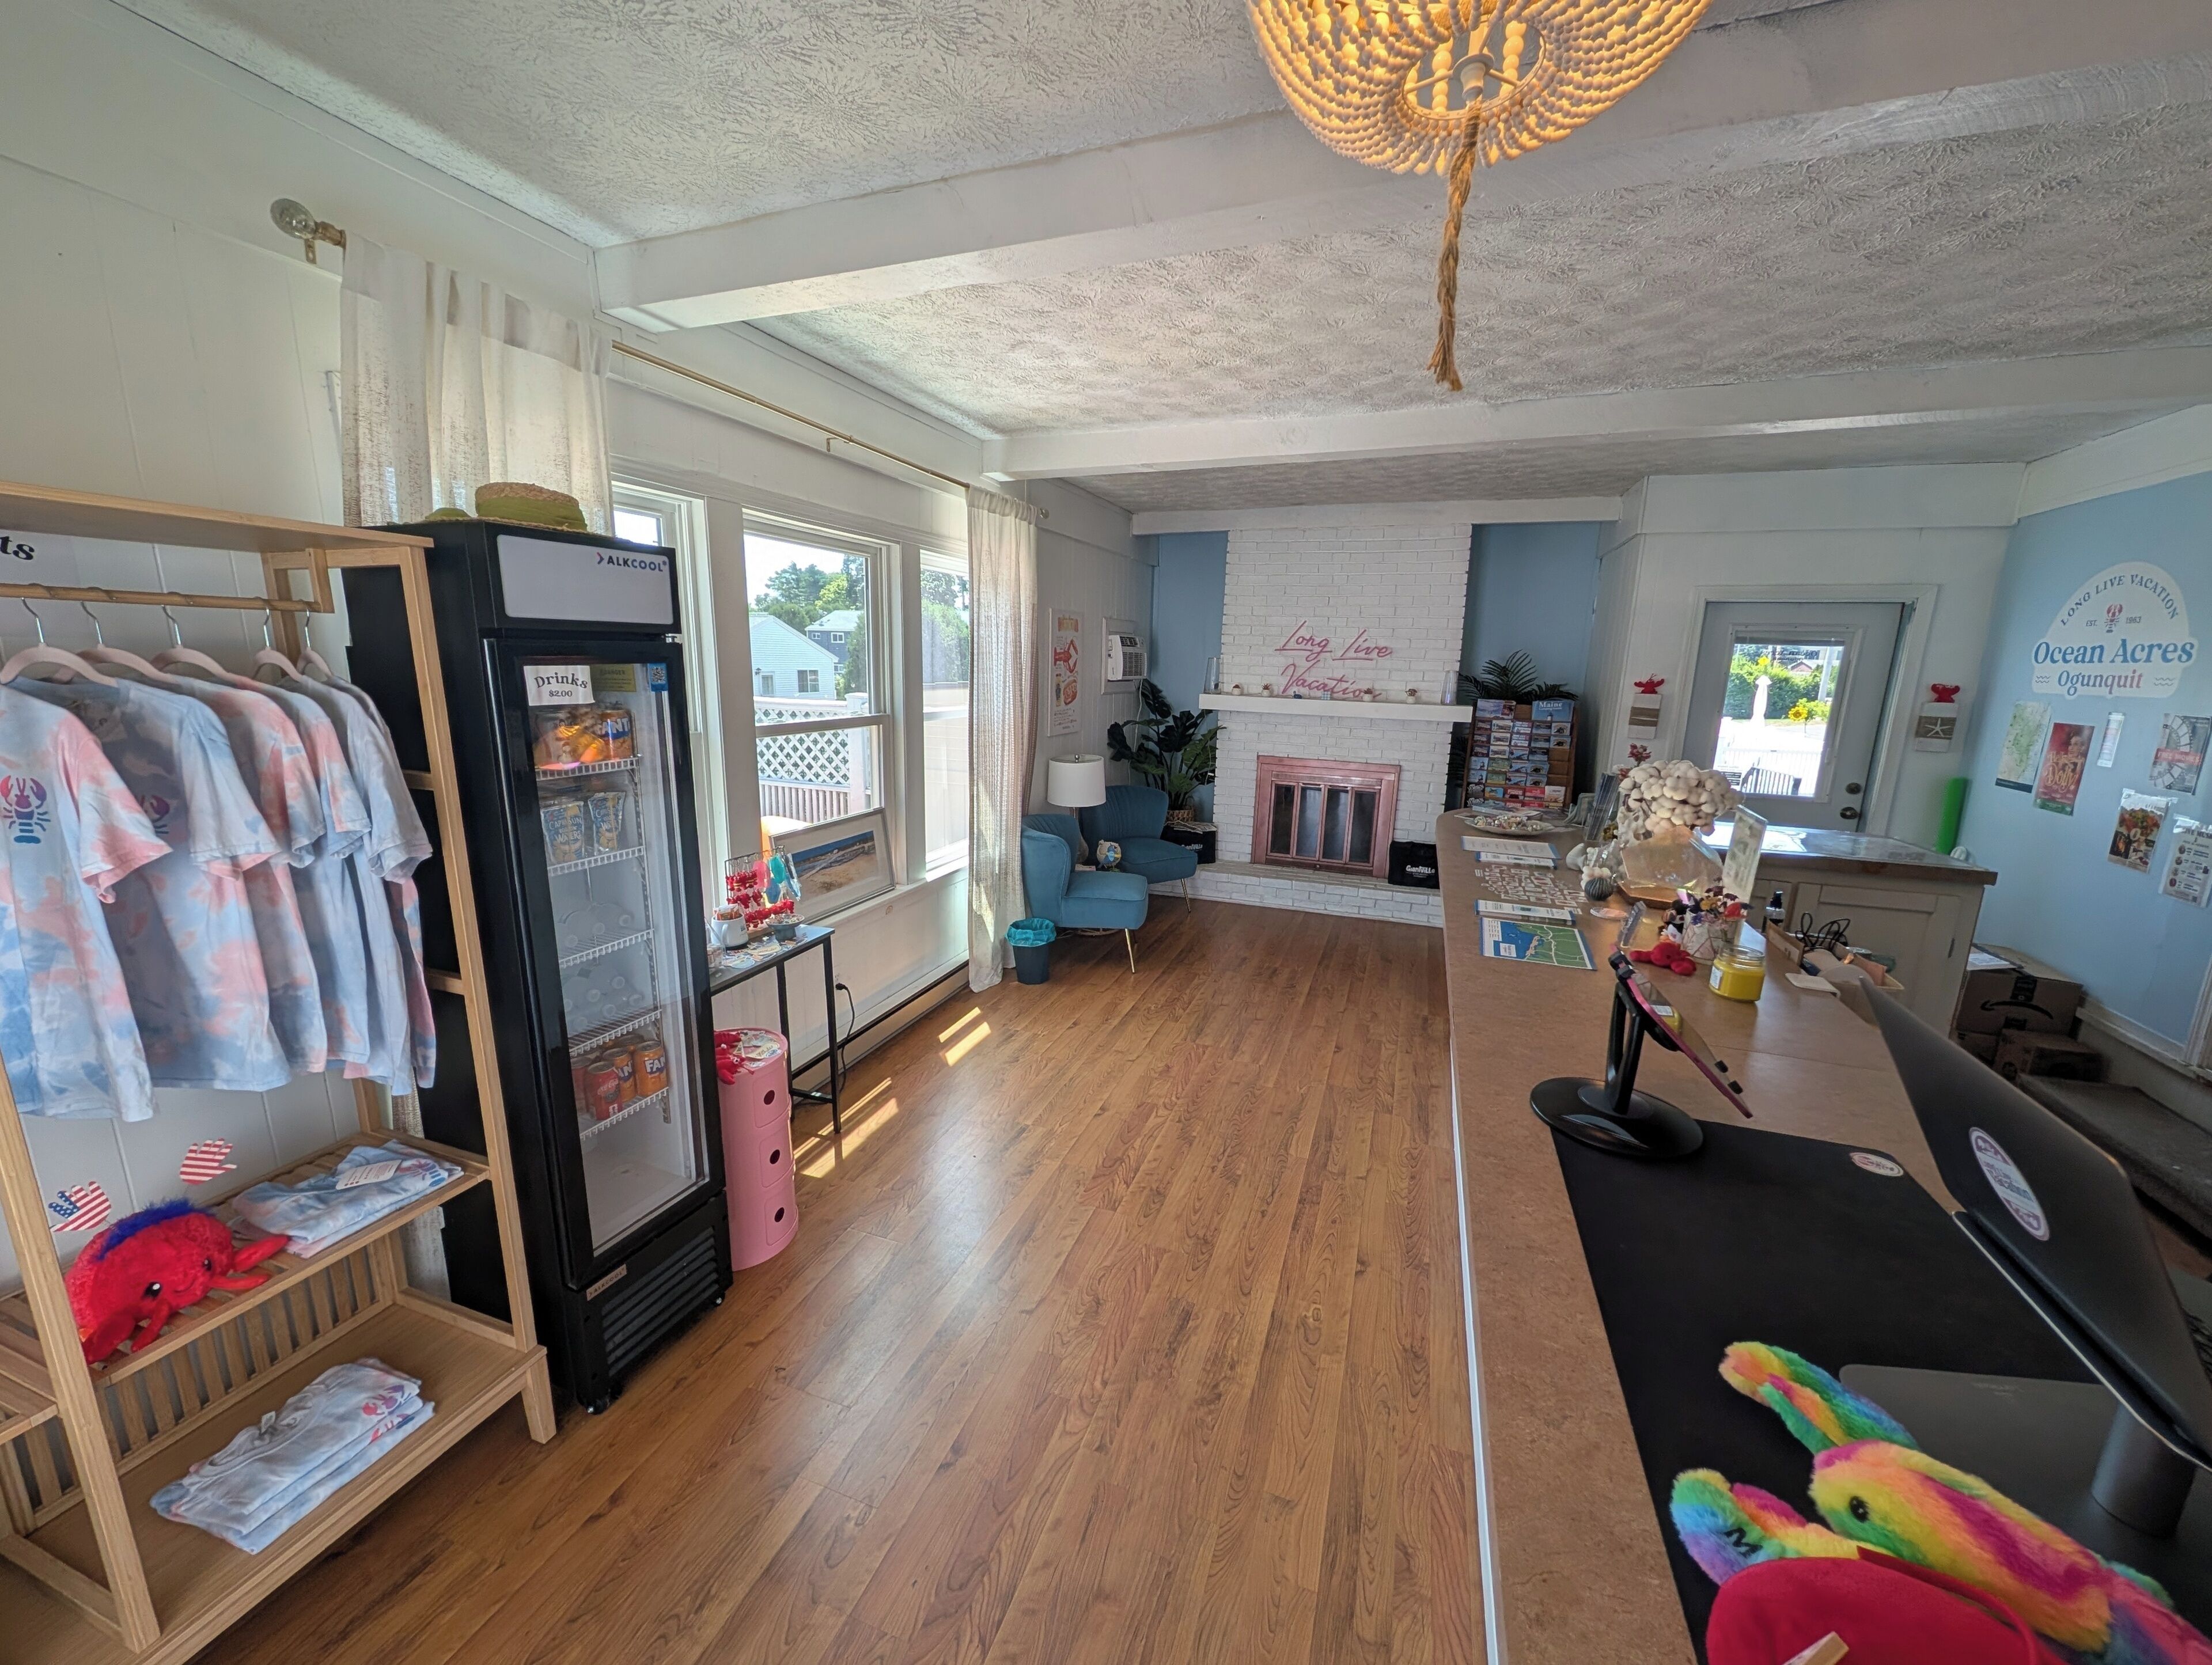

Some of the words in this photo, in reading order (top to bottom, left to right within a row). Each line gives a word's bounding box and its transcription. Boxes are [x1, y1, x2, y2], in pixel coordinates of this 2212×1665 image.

[607, 555, 663, 572] ALKCOOL
[2061, 592, 2091, 626] LONG
[2095, 575, 2125, 595] LIVE
[2130, 574, 2179, 619] VACATION
[1274, 620, 1333, 662] Long
[1332, 629, 1393, 661] Live
[2033, 641, 2105, 664] Ocean
[2108, 638, 2195, 663] Acres
[533, 672, 588, 689] Drinks
[548, 689, 573, 697] $2.00
[2057, 669, 2143, 696] Ogunquit
